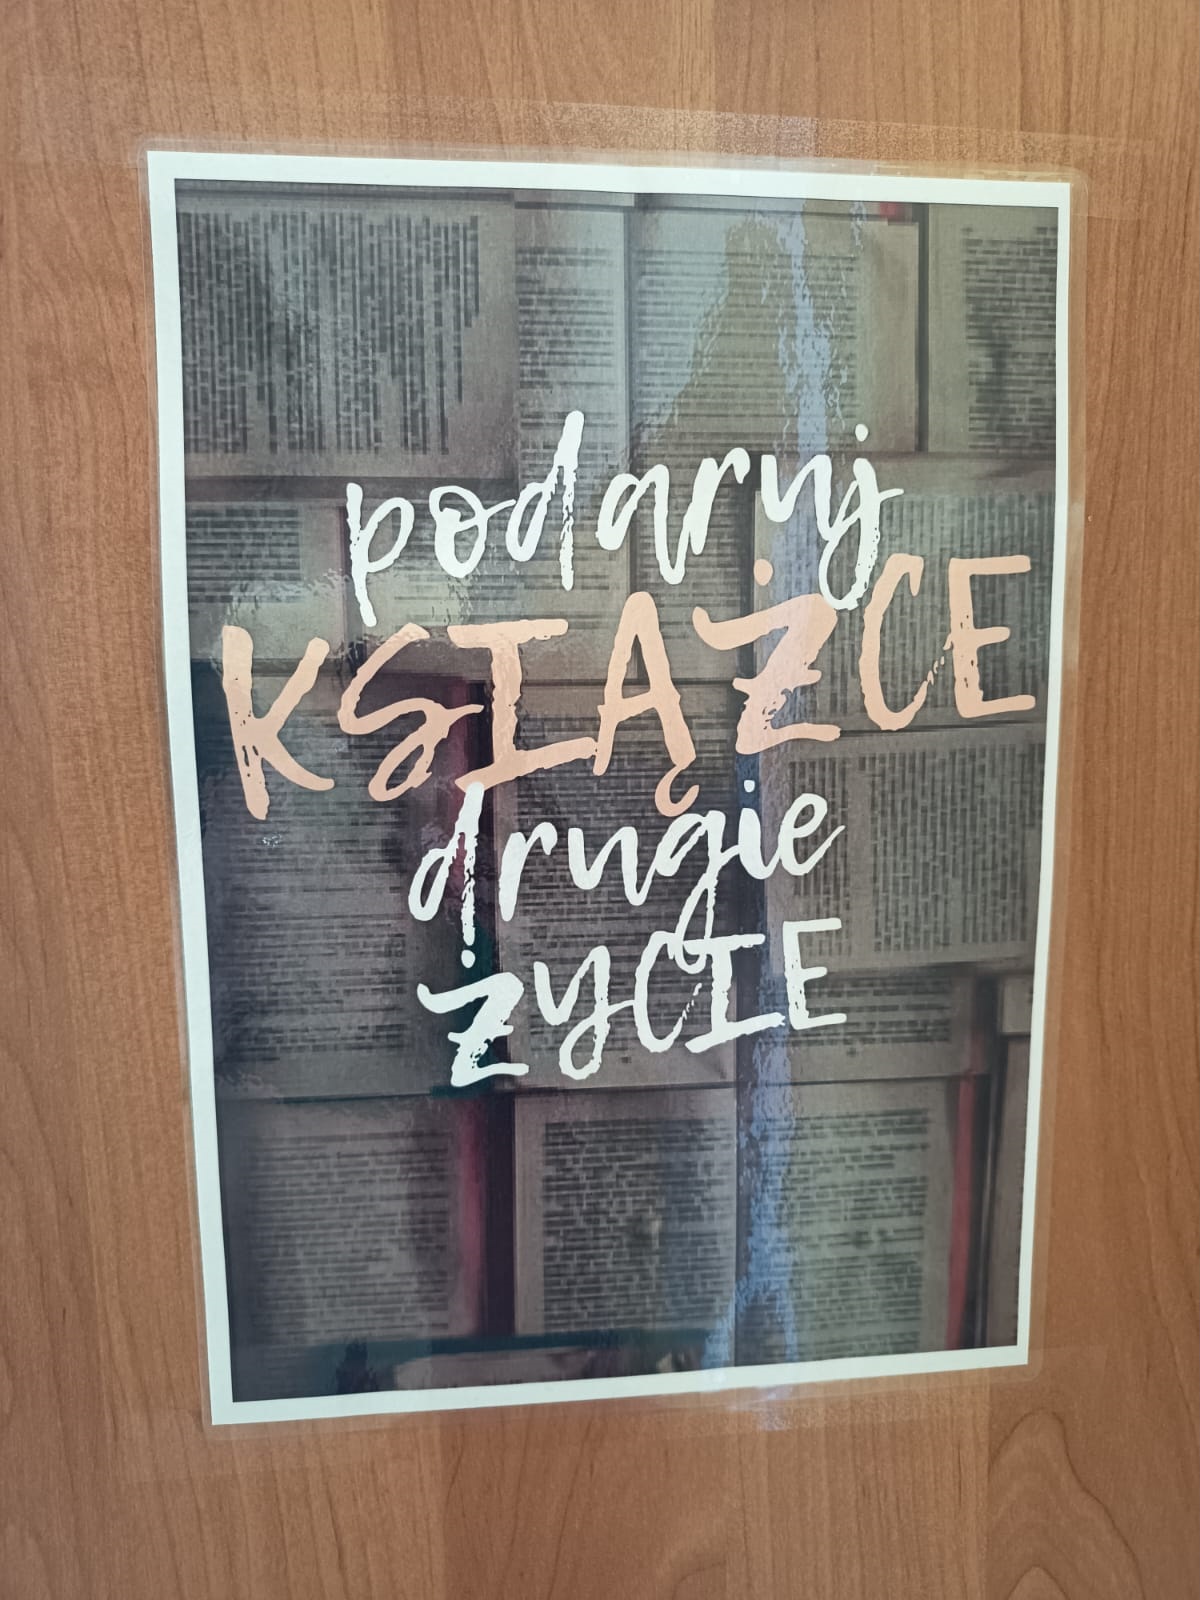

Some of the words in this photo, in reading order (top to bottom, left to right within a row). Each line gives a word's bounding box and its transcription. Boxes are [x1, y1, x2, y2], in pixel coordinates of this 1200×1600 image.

[346, 409, 904, 627] podaruj
[222, 553, 1036, 821] KSIĄŻCE
[408, 780, 846, 970] drugie
